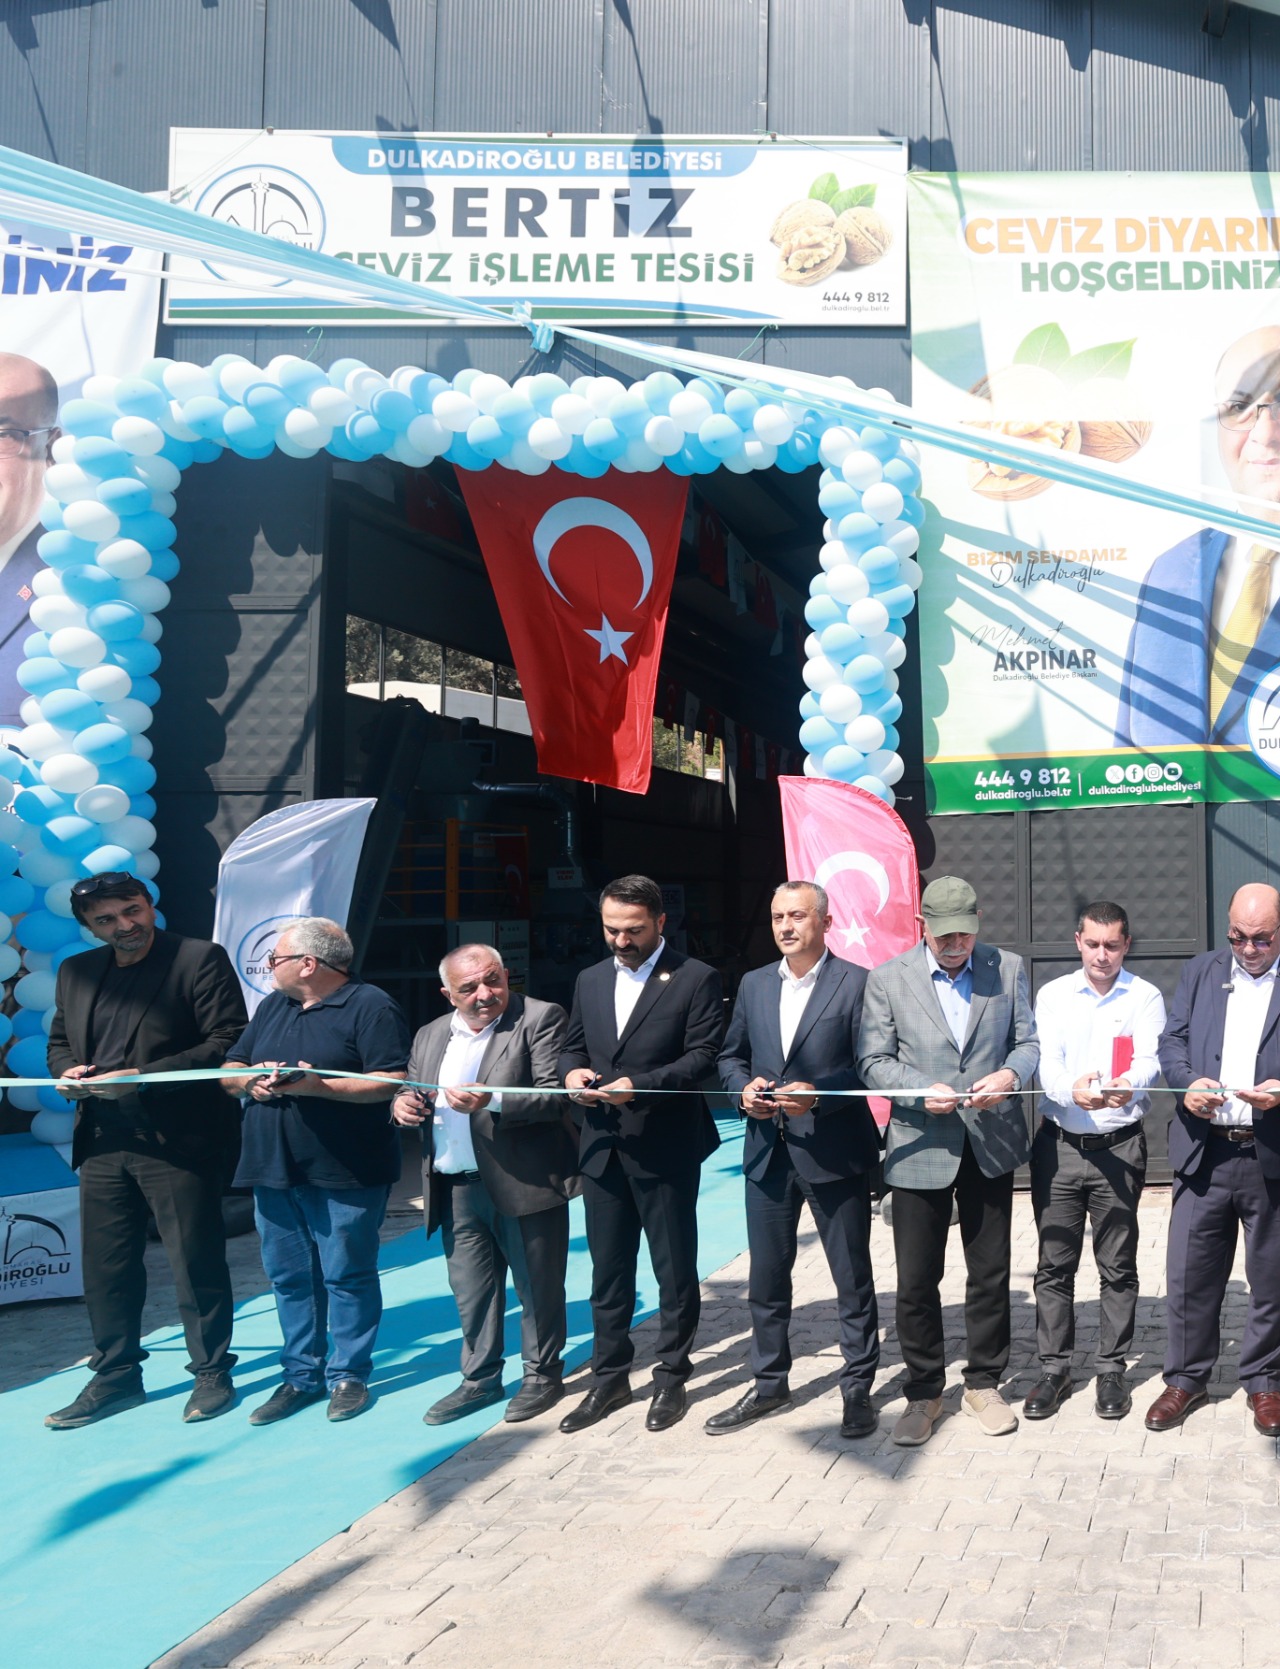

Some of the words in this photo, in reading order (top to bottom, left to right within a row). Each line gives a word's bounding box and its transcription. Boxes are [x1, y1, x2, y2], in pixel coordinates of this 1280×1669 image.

[964, 215, 1104, 254] CEVİZ
[469, 252, 615, 286] İŞLEME
[631, 252, 754, 283] TESİSİ
[822, 291, 851, 303] 444
[854, 291, 863, 303] 9
[867, 291, 890, 303] 812
[1026, 547, 1128, 564] SEVDAMIZ
[970, 620, 1069, 650] Mehmet
[993, 649, 1097, 672] AKPINAR
[1041, 672, 1070, 680] Belediye
[974, 770, 1015, 787] 444
[1020, 769, 1032, 785] 9
[1038, 767, 1071, 784] 812
[975, 787, 1072, 800] dulkadiroglu.bel.tr
[0, 1262, 71, 1282] İROĞLU
